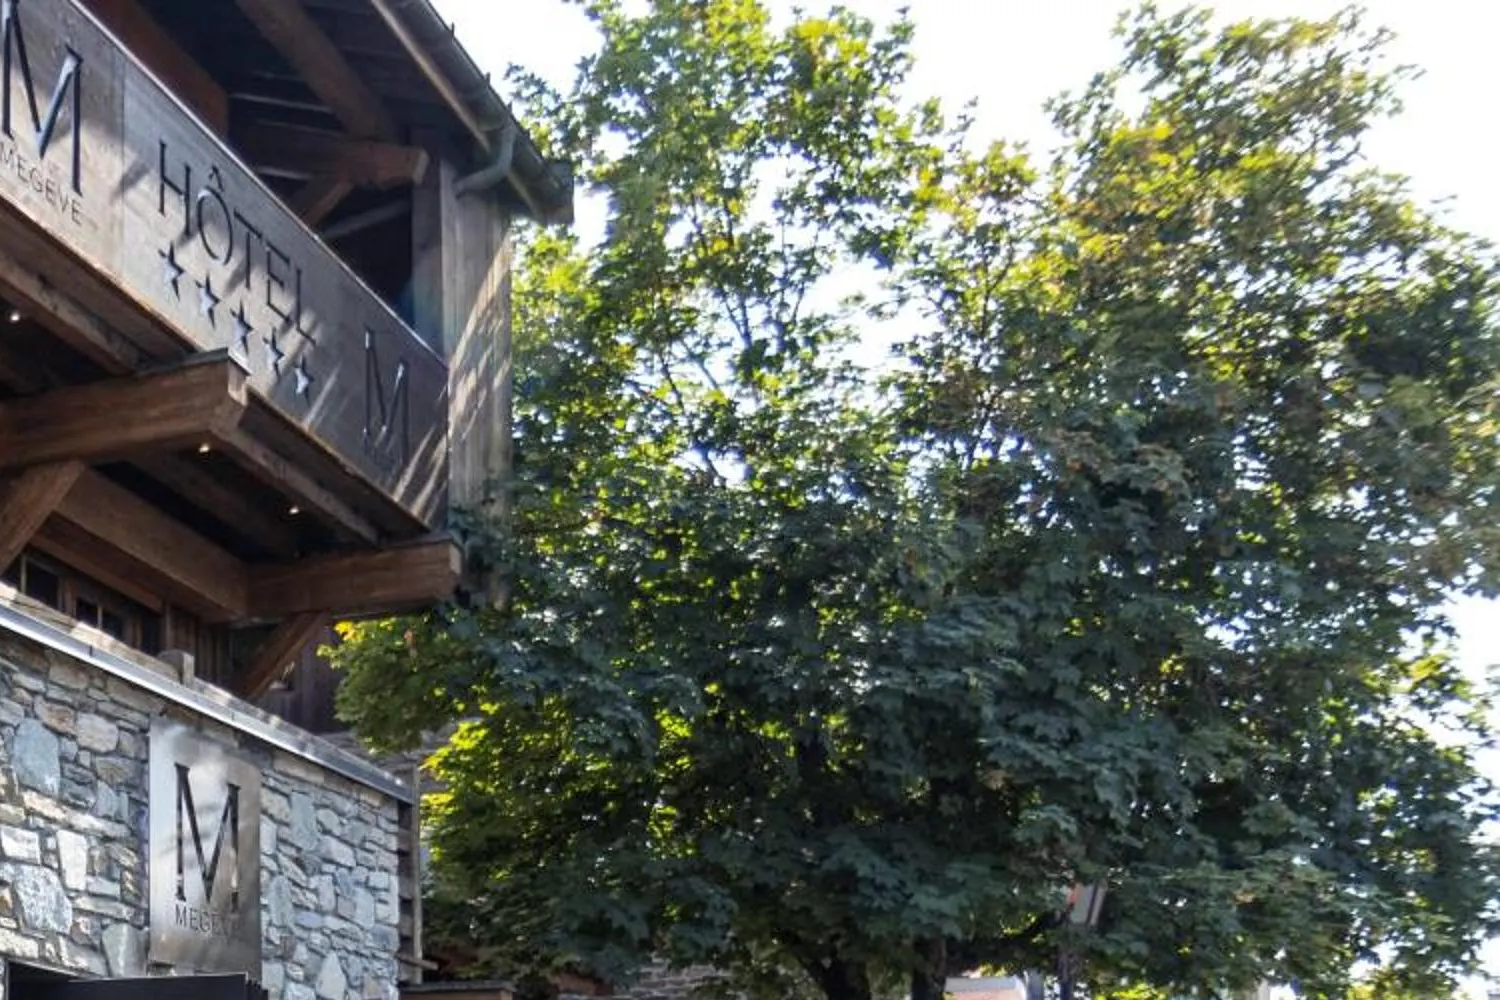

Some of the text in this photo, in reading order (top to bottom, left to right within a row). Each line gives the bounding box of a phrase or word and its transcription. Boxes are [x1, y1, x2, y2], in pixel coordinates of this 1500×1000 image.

[0, 0, 84, 197] M
[158, 139, 317, 346] HÔTEL
[362, 325, 412, 468] M
[174, 762, 241, 913] M
